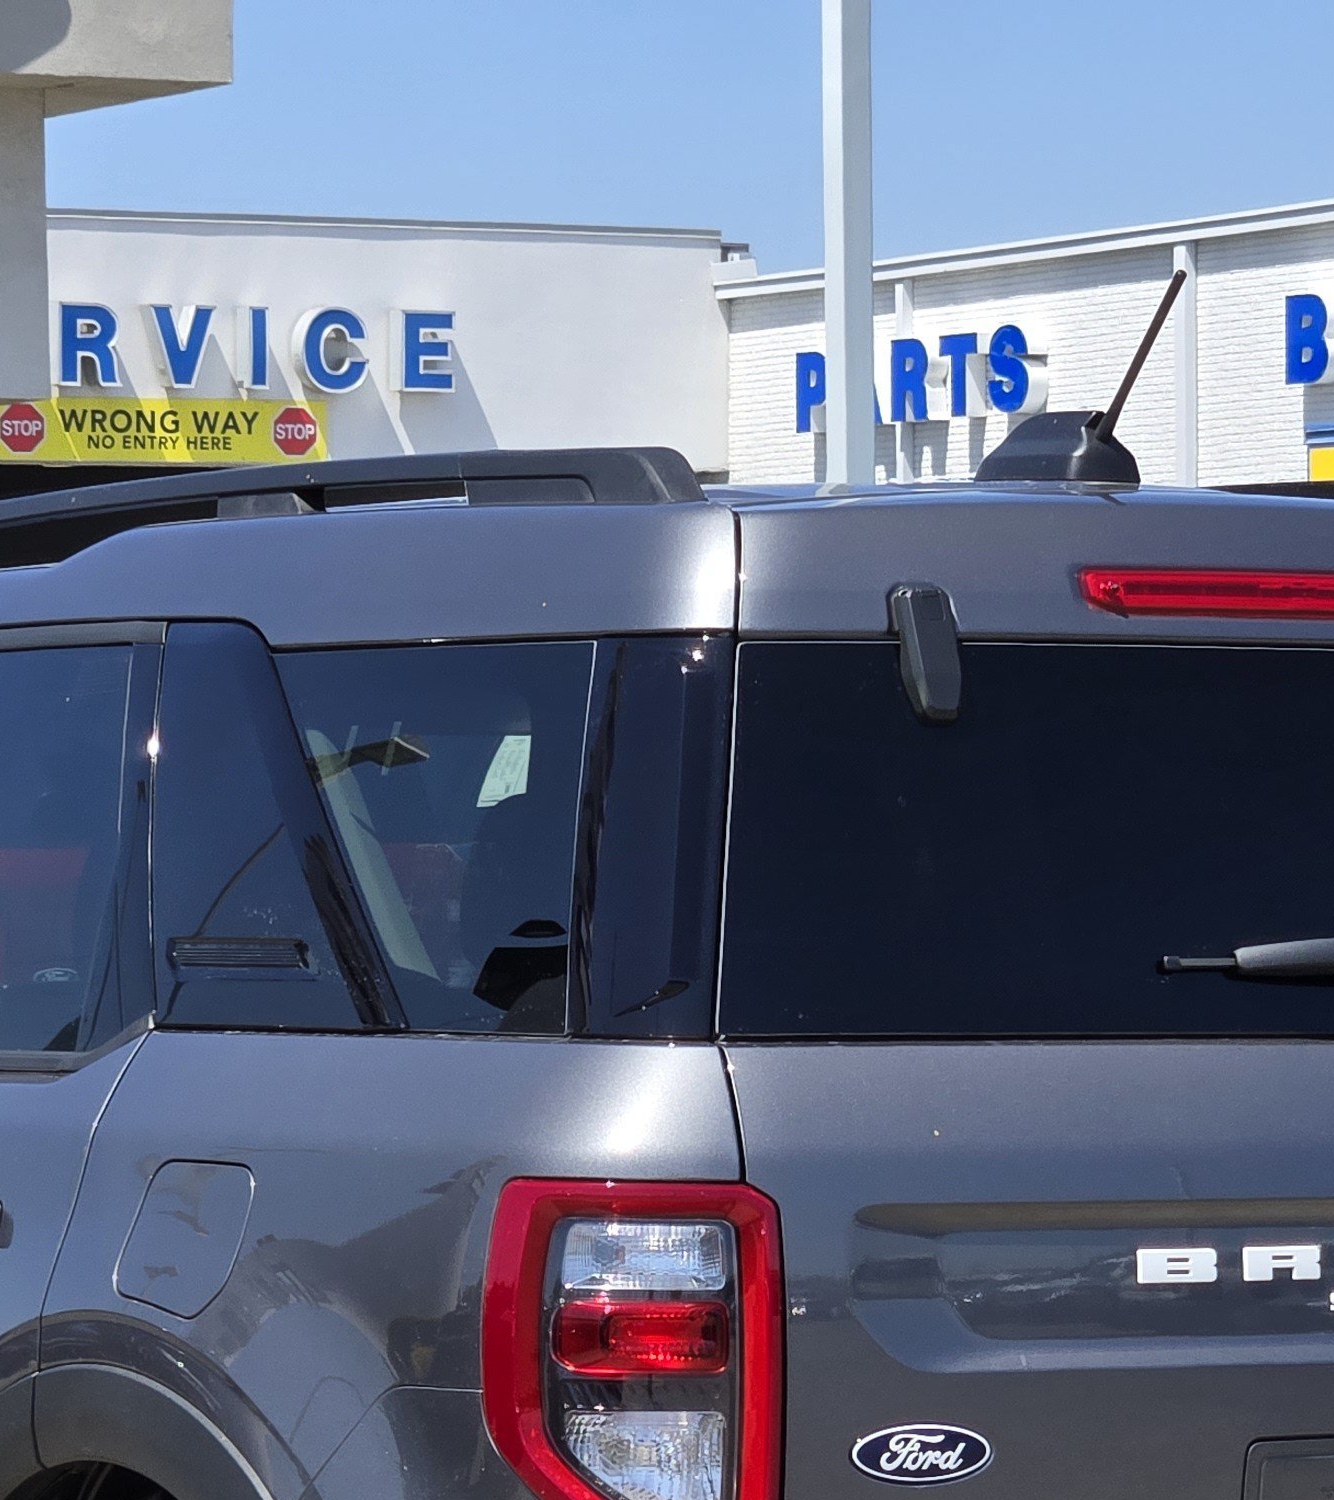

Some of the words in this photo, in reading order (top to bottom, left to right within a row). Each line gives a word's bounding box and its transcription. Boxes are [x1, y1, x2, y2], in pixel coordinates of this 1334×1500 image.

[795, 324, 1029, 433] PRTS
[1, 418, 42, 437] STOP
[58, 408, 180, 434] WRONG
[192, 410, 260, 435] WAY
[274, 422, 316, 440] STOP
[87, 435, 115, 450] NO
[122, 435, 180, 450] ENTRY
[186, 436, 232, 451] HERE
[879, 1433, 966, 1471] Ford
